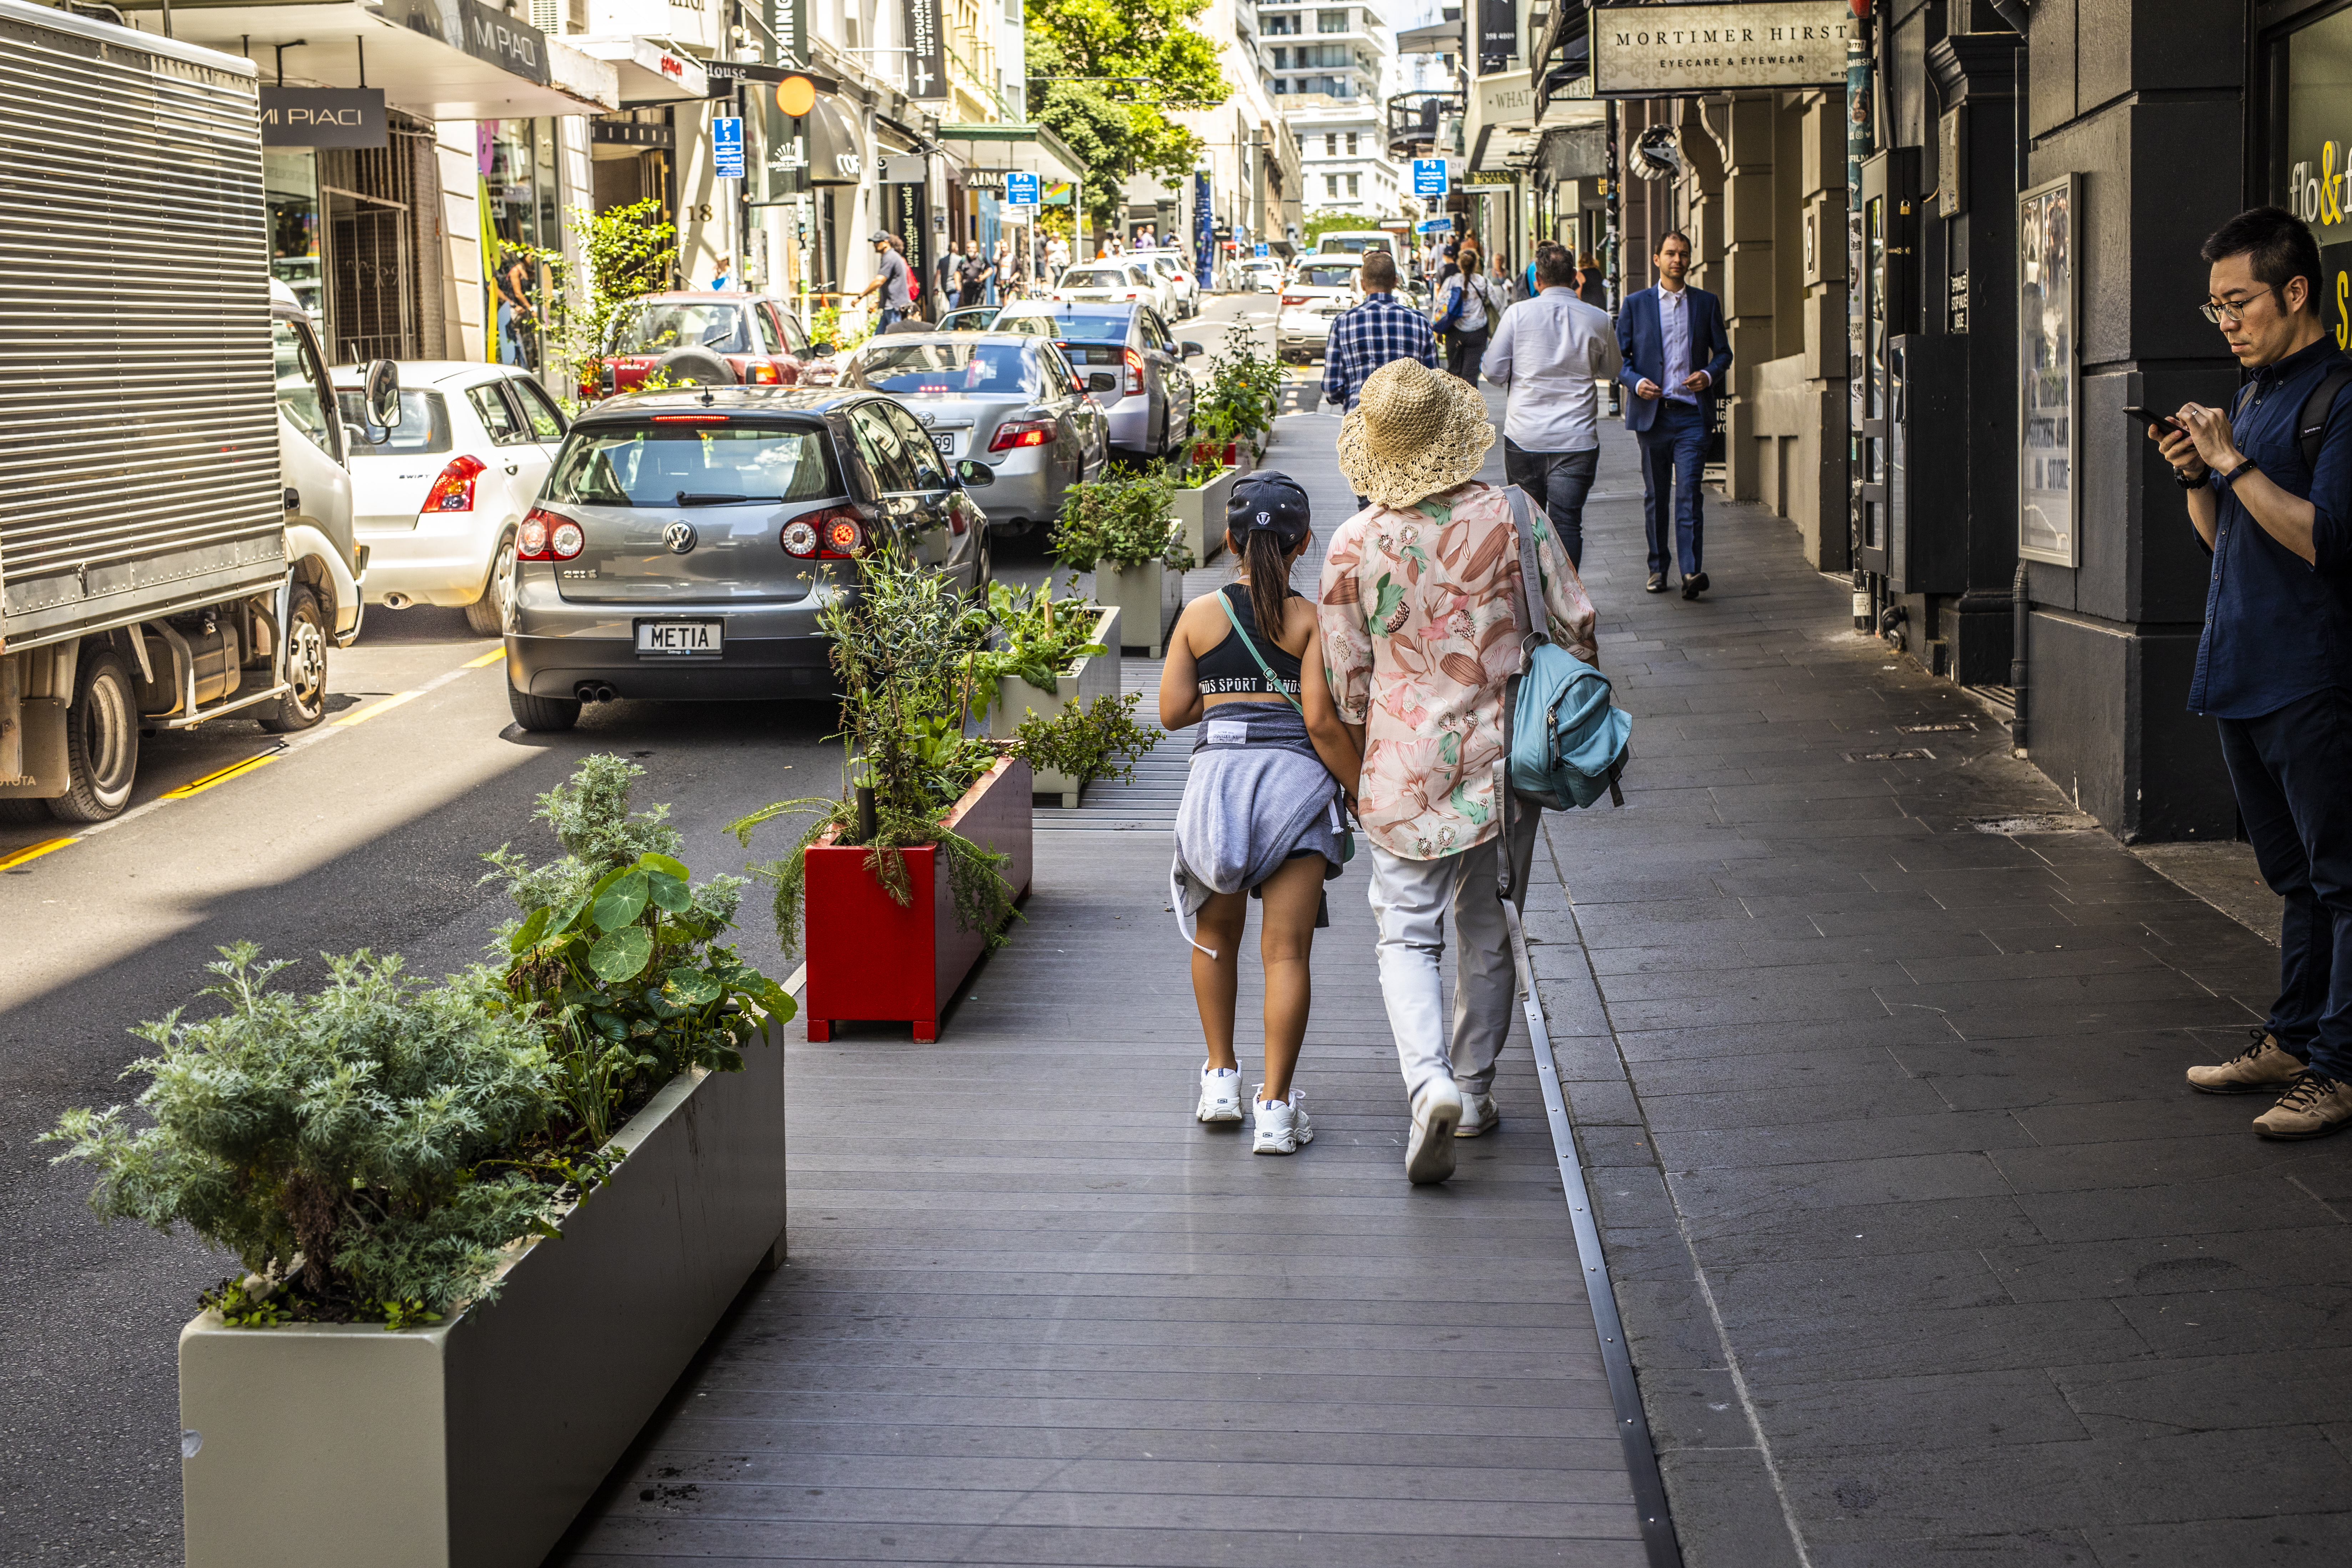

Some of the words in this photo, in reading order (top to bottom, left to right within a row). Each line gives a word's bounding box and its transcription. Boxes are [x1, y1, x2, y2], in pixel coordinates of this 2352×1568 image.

[924, 0, 934, 34] ZEALAN
[474, 16, 496, 50] MI
[496, 25, 536, 67] PIACI
[1616, 29, 1753, 45] MORTIMER
[1771, 25, 1846, 40] HIRST
[1660, 58, 1719, 67] EYECARE
[1727, 57, 1734, 66] &
[1742, 55, 1804, 65] EYEWEAR
[1496, 89, 1531, 108] WHAT
[288, 109, 362, 125] PIACI
[722, 119, 732, 131] P
[902, 187, 913, 216] world
[686, 203, 712, 222] 18
[904, 217, 914, 267] untouched
[1952, 274, 1966, 293] SPRINKLER
[2337, 271, 2352, 347] S
[2048, 458, 2068, 490] STORE
[564, 570, 586, 578] GTI
[651, 627, 709, 647] METIA
[1219, 678, 1257, 691] SPORT
